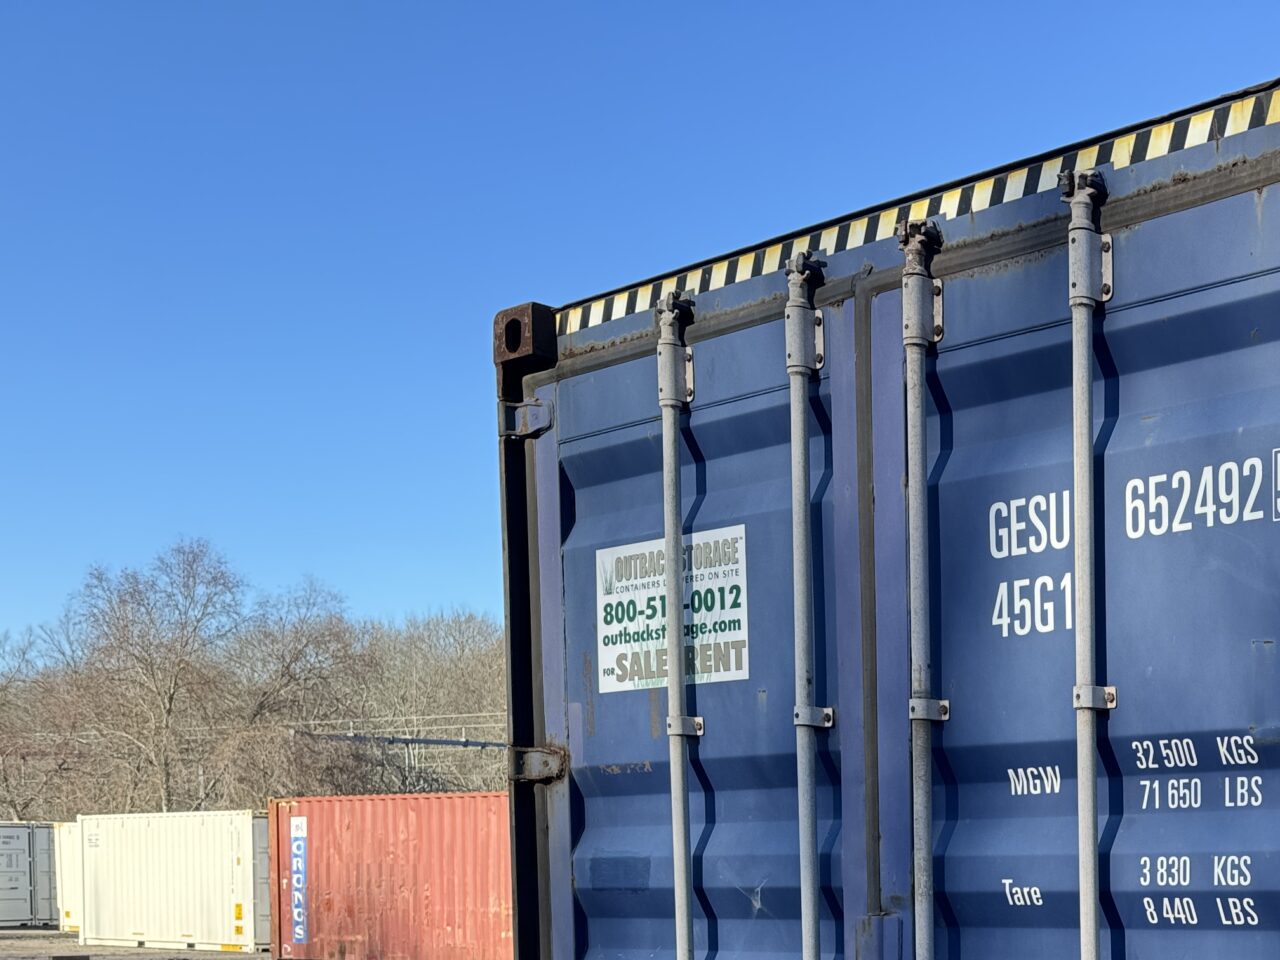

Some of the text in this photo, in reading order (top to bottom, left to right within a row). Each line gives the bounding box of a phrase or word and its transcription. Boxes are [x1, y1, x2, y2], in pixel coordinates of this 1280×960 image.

[990, 490, 1070, 559] GESU
[1125, 457, 1264, 539] 652492
[614, 549, 665, 583] OUTBAC
[707, 568, 740, 580] ON SITE
[615, 580, 661, 595] CONTAINERS
[603, 584, 741, 626] 800-51-0012
[992, 572, 1073, 637] 45G1
[602, 618, 741, 647] outbackstage.com
[603, 640, 746, 683] FOR SALE RENT
[1132, 735, 1259, 769] 32 500 KGS
[1008, 765, 1061, 796] MGW
[1139, 776, 1263, 809] 71 650 LBS
[1140, 856, 1251, 886] 3 830 KGS
[1002, 879, 1043, 906] Tare
[1143, 897, 1259, 925] 8 440 LBS
